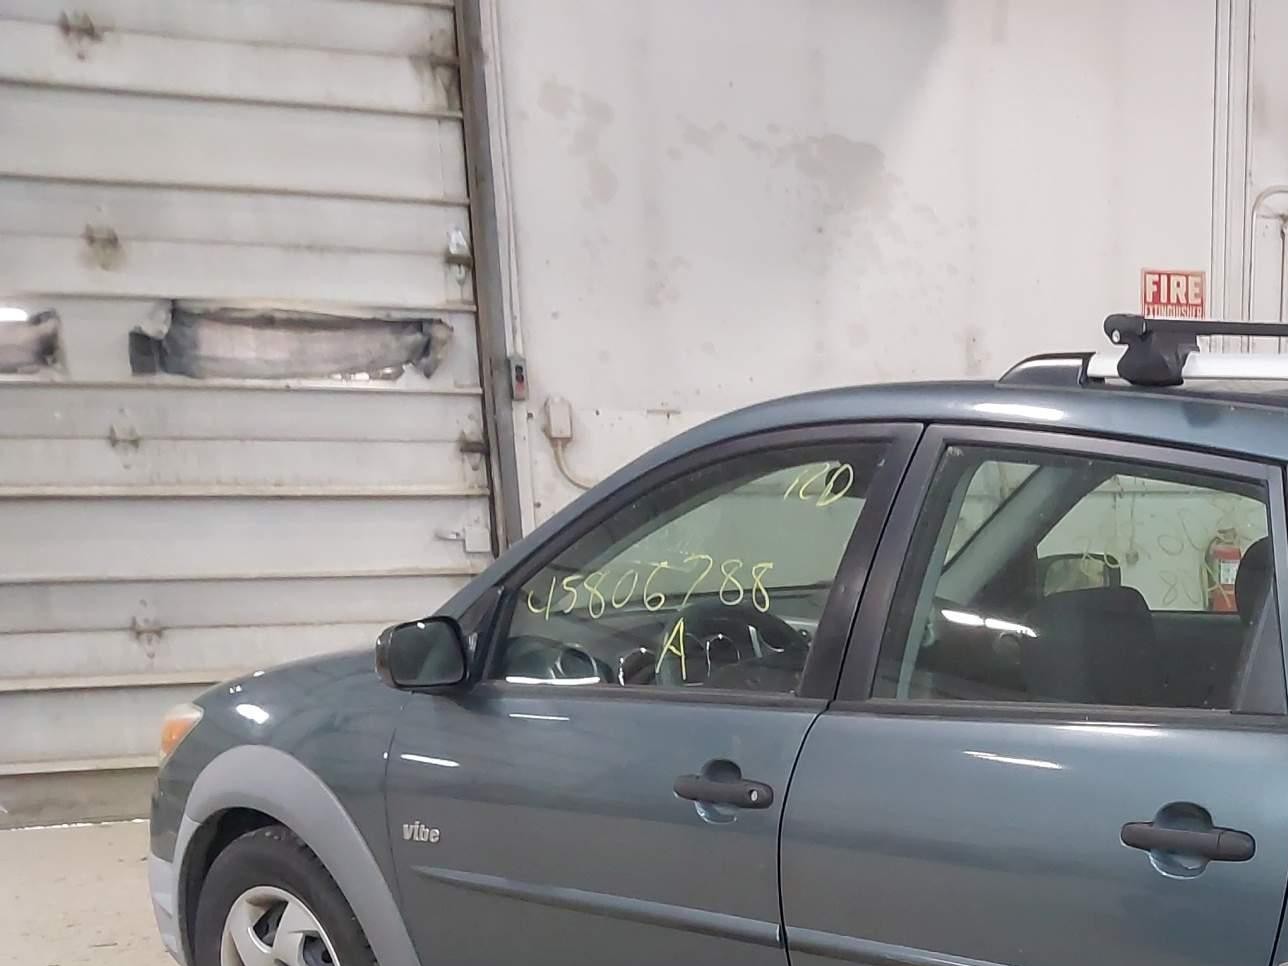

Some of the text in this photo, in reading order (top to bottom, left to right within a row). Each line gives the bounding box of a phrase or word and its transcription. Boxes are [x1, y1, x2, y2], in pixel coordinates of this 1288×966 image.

[1145, 273, 1202, 305] FIRE
[527, 554, 774, 621] 45806788
[655, 617, 688, 681] A
